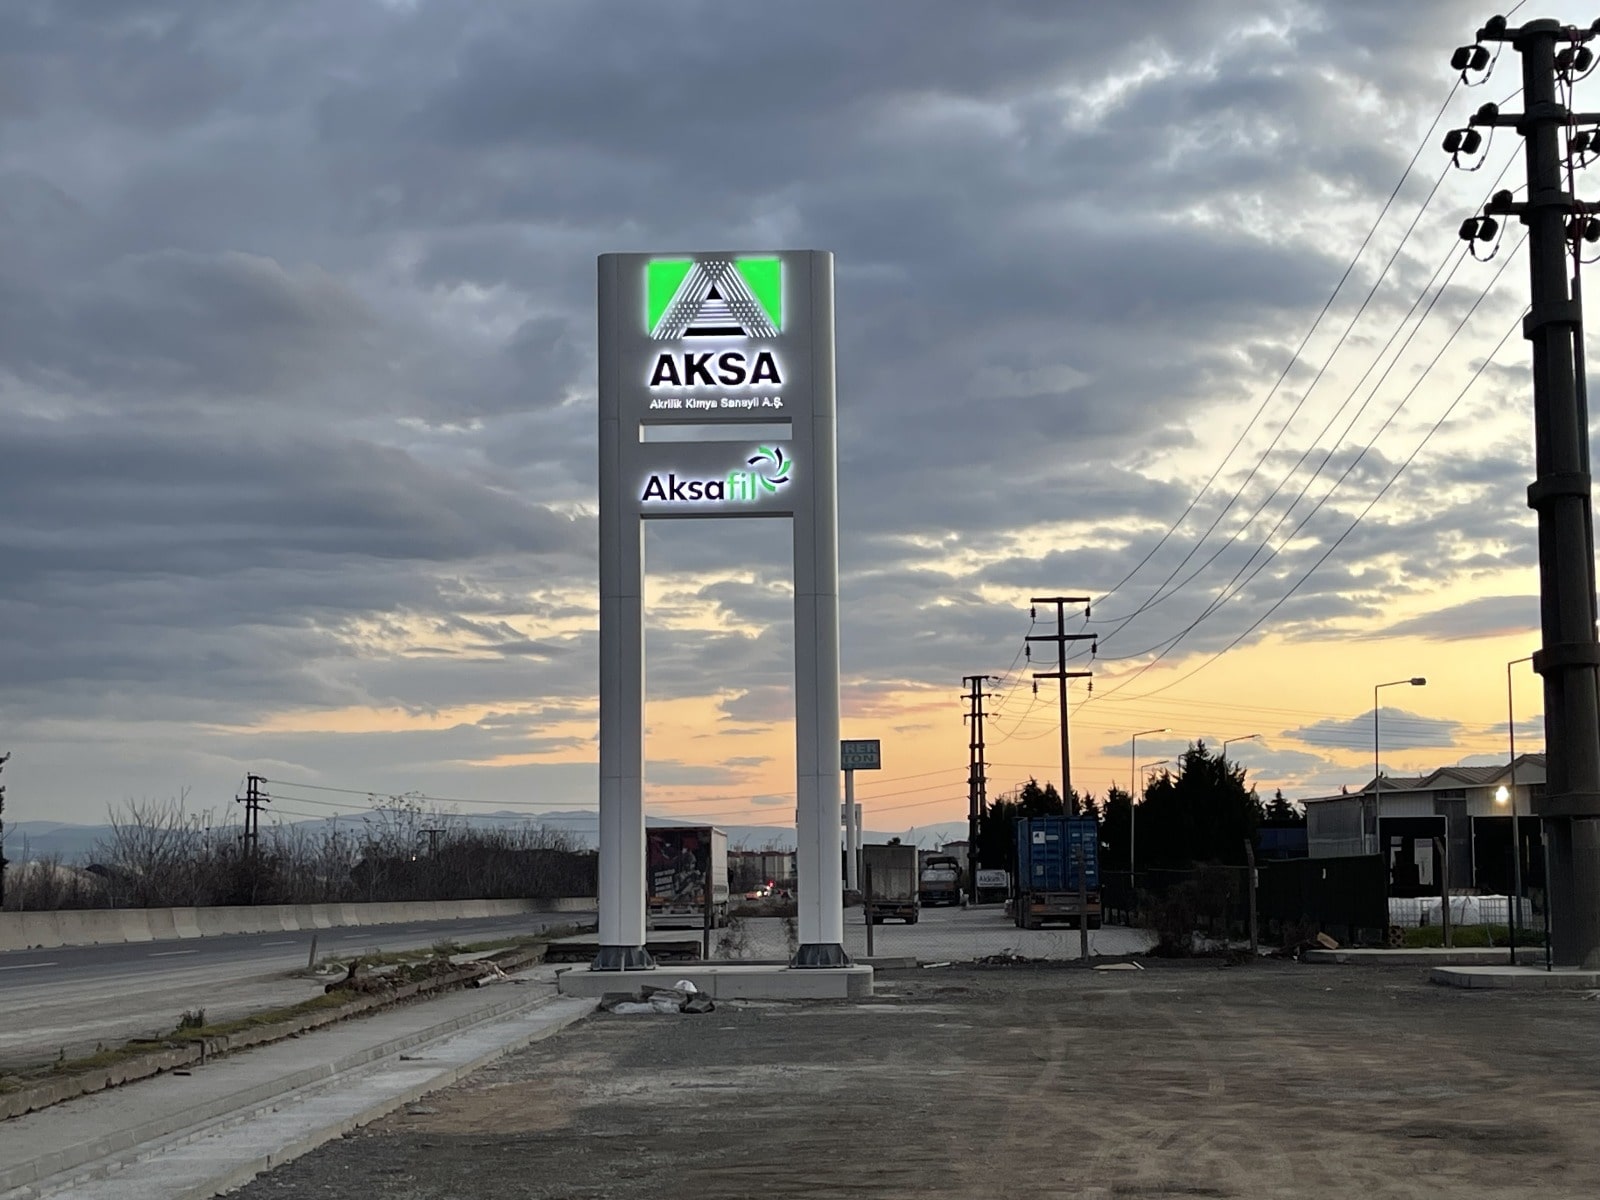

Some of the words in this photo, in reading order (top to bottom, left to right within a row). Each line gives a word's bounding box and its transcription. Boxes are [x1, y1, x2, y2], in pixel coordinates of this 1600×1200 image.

[650, 352, 782, 386] AKSA
[650, 398, 683, 409] Akrilik
[685, 398, 718, 411] Kimya
[720, 397, 759, 410] Sanayii
[762, 396, 784, 409] A.Ş.
[642, 471, 757, 501] Aksafil
